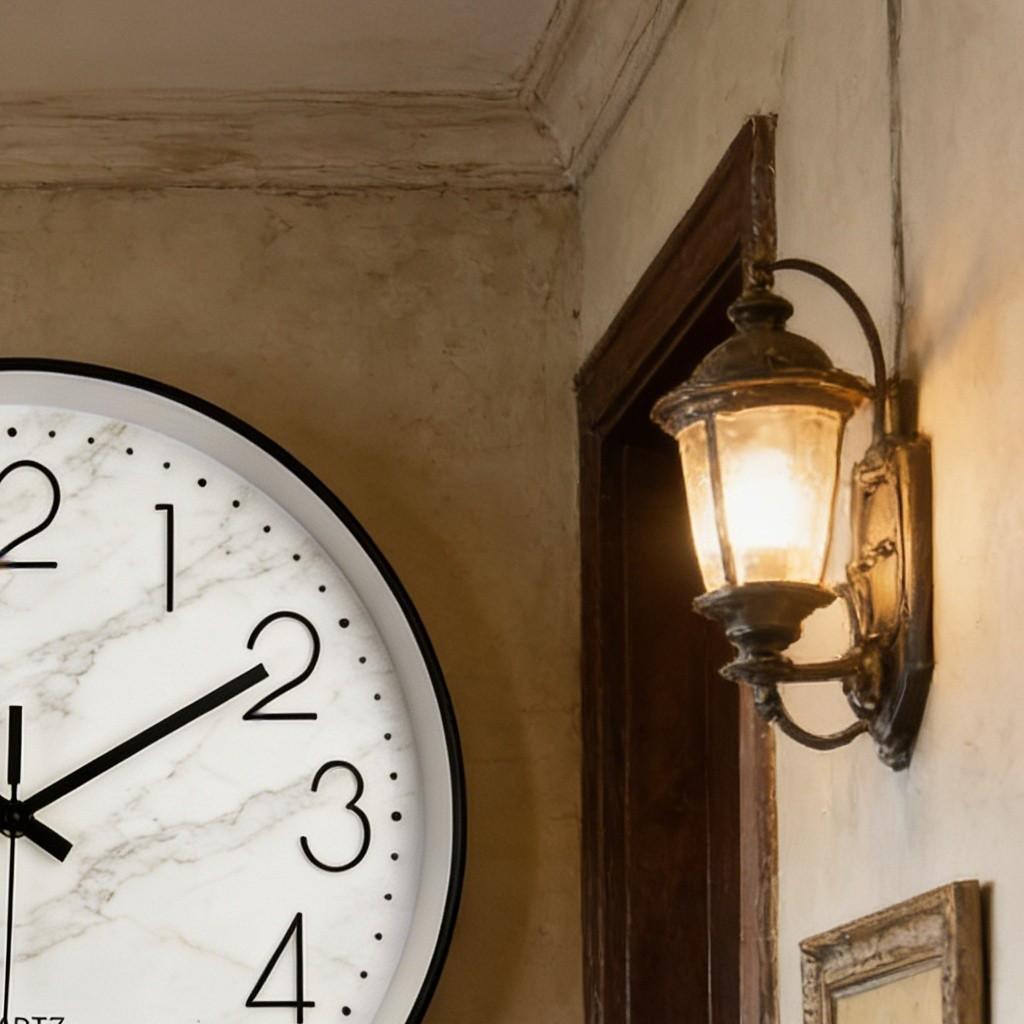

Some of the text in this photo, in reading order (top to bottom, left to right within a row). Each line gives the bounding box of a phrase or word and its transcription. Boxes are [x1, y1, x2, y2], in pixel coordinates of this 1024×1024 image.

[154, 503, 174, 613] 1
[242, 610, 321, 721] 2
[299, 760, 371, 873] 3
[245, 911, 316, 1024] 4
